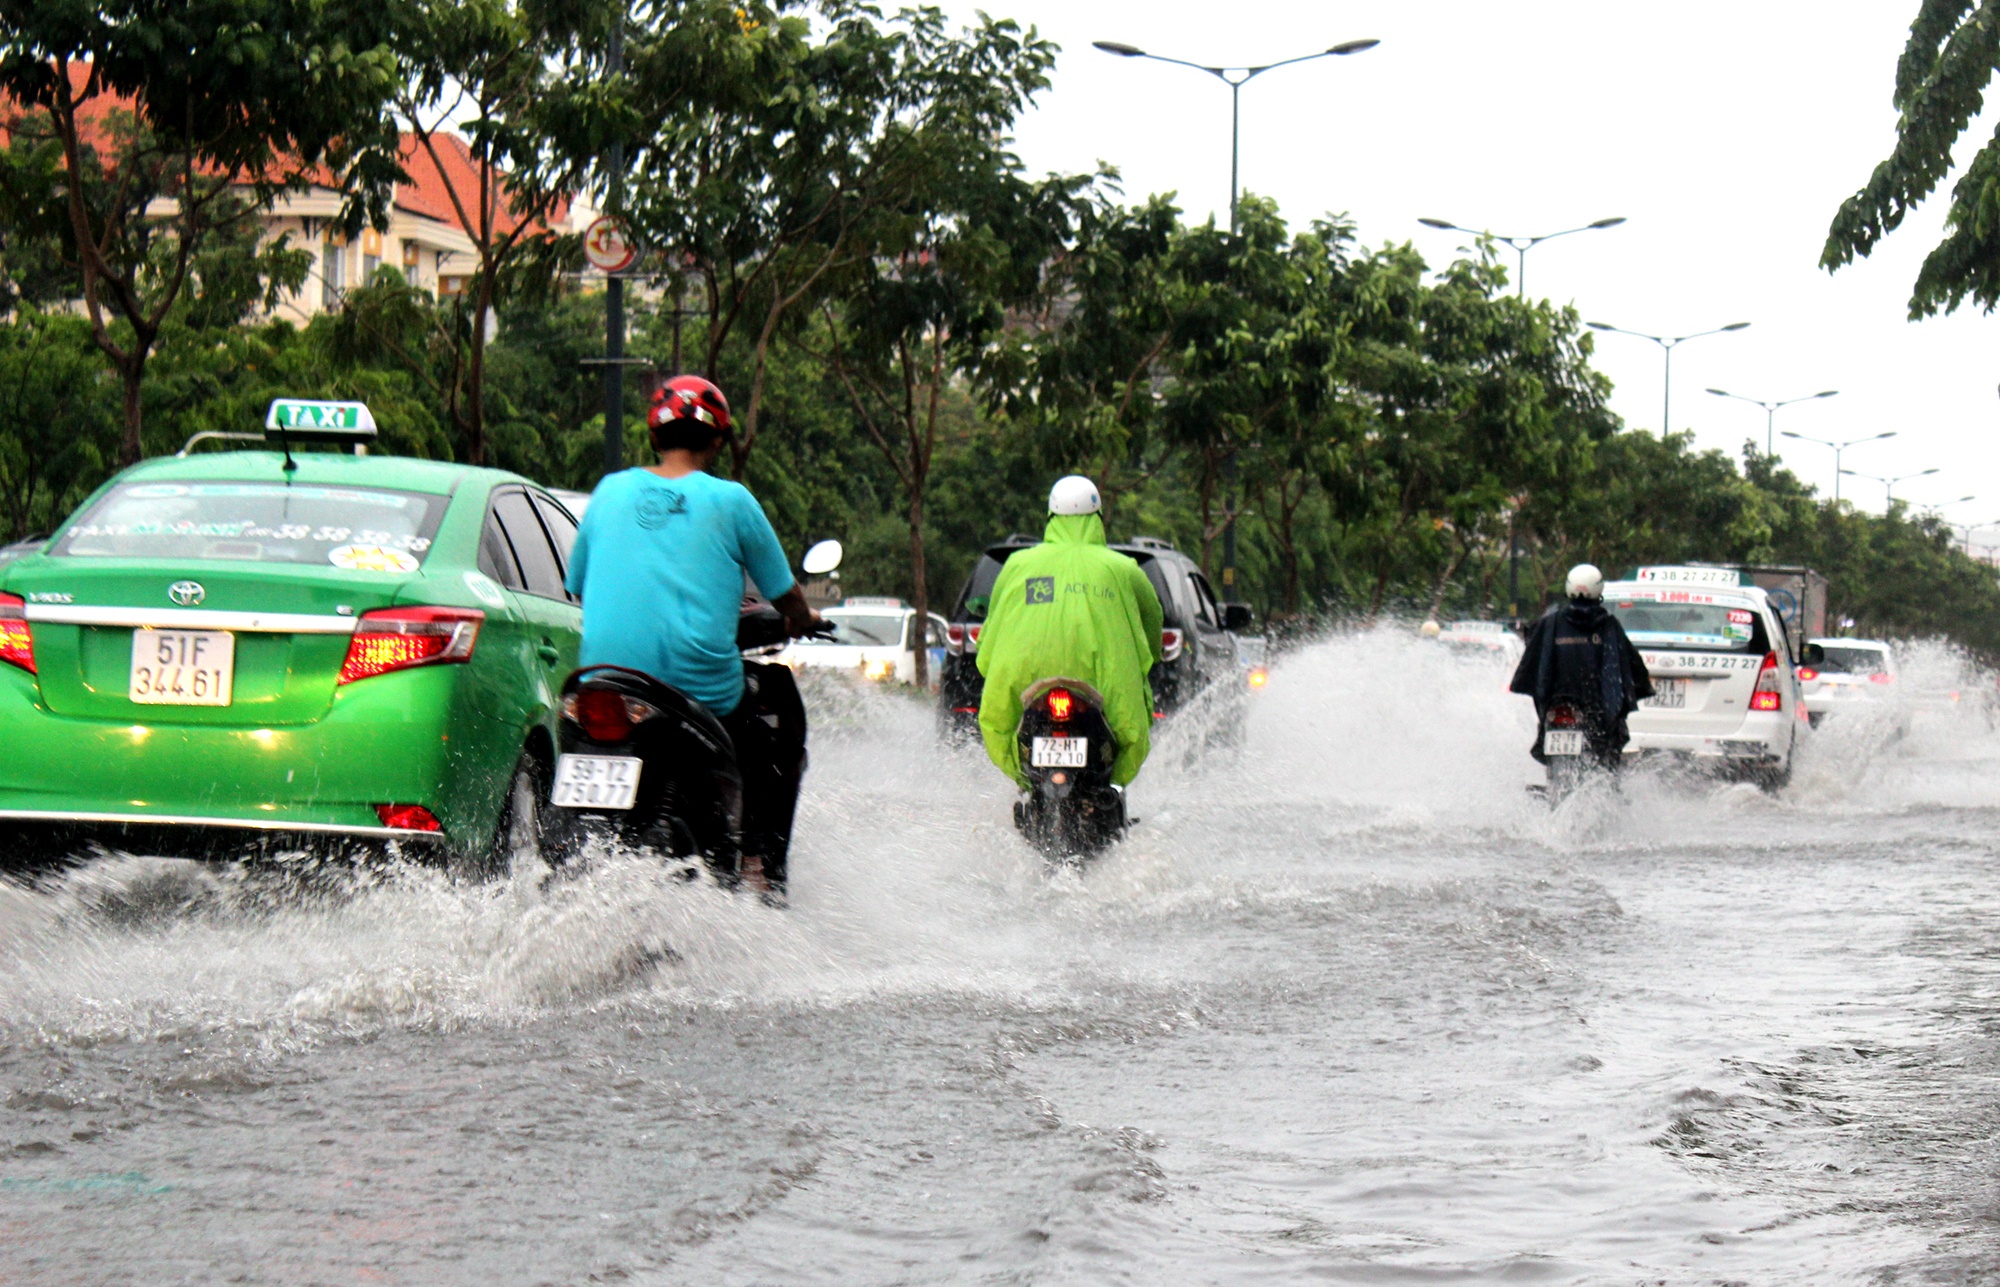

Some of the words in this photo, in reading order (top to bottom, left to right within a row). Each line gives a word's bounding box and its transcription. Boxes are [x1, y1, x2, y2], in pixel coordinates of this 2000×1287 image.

[1064, 582, 1089, 595] ACE
[1093, 586, 1115, 600] Life
[157, 635, 209, 667] 51F
[1042, 739, 1078, 751] 72-H1
